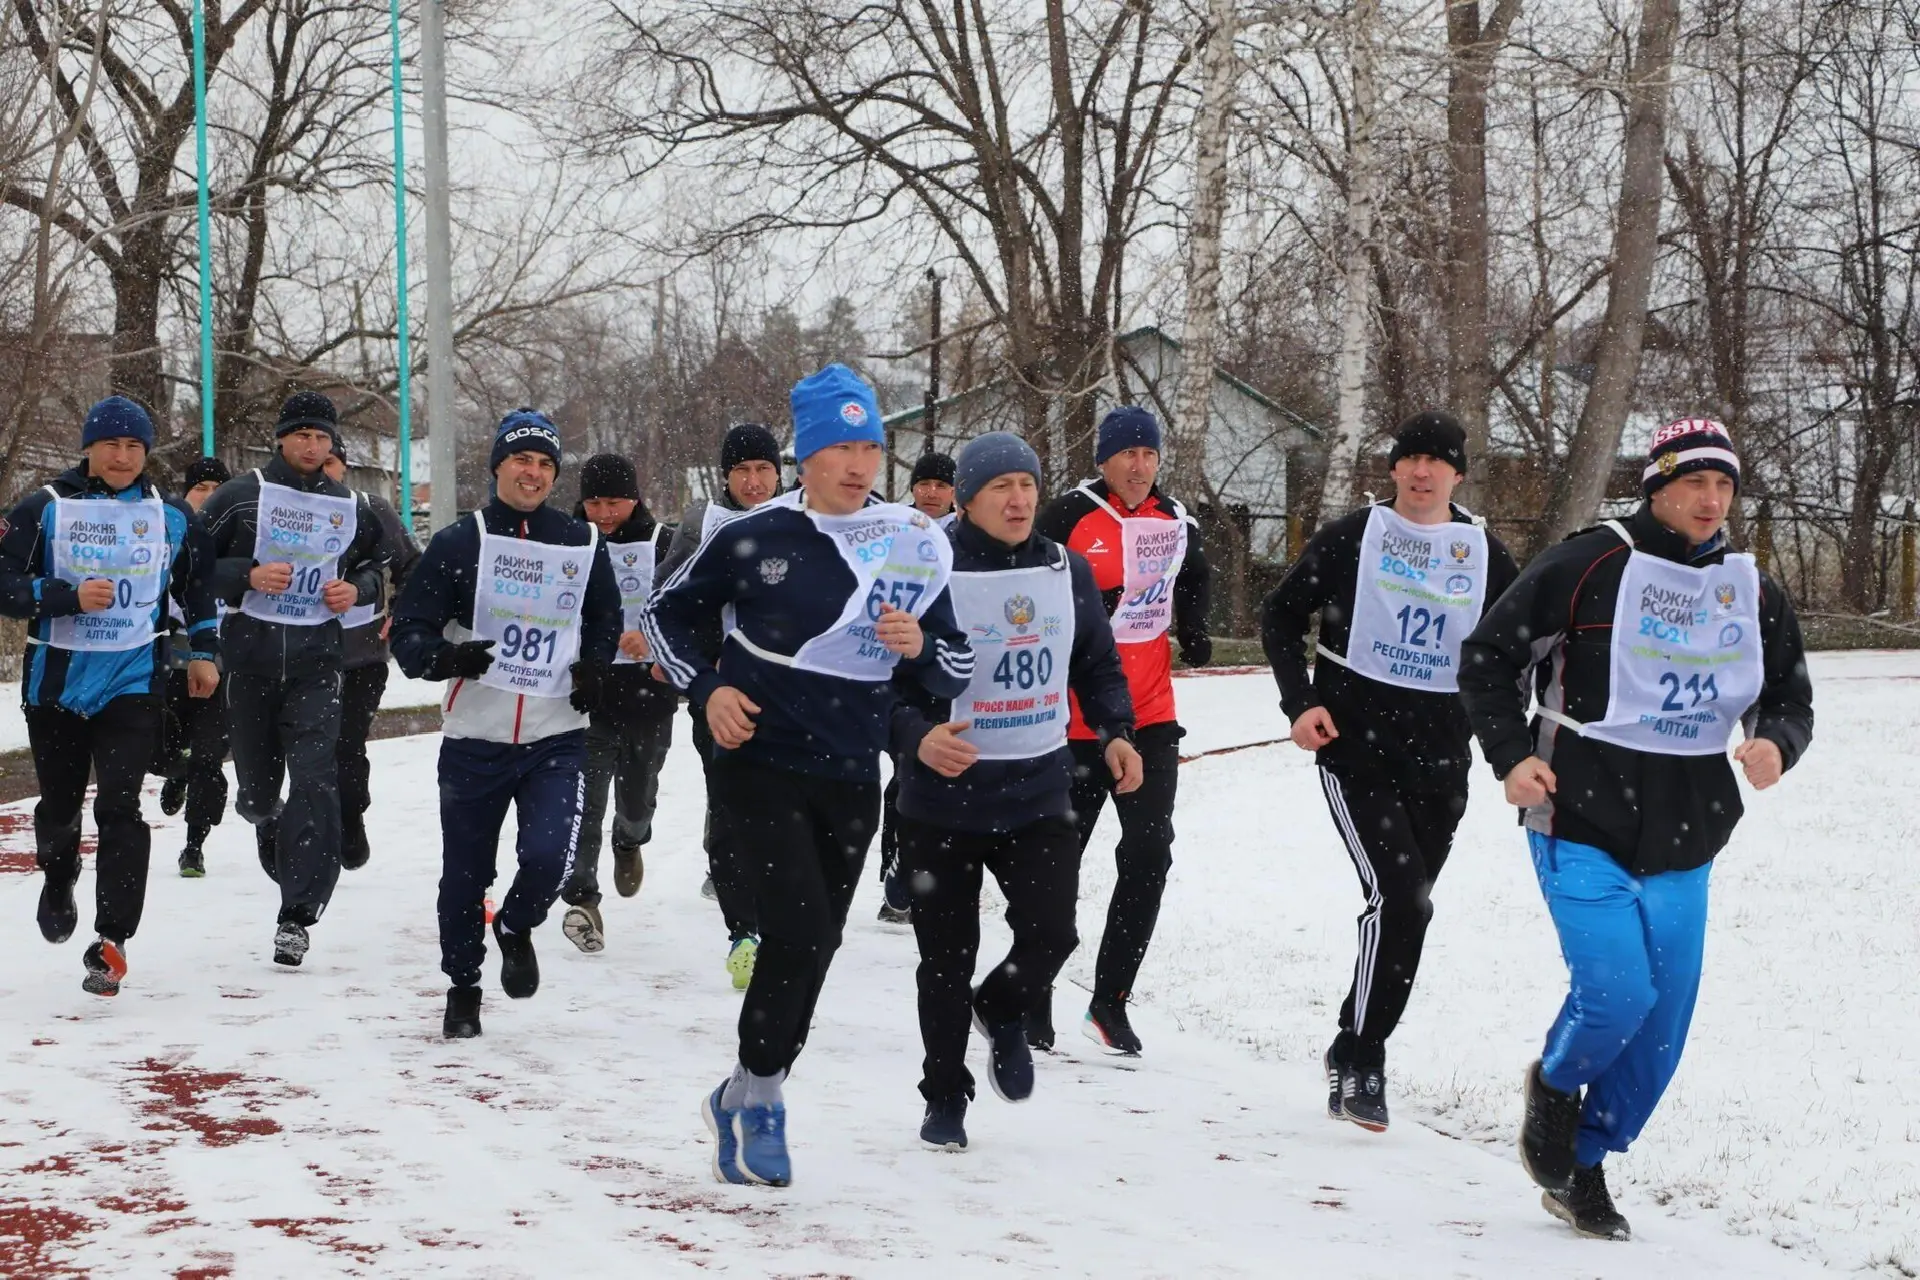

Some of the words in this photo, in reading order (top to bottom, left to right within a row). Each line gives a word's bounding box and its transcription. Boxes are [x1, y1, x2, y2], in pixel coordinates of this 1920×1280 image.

[505, 427, 560, 450] BOSCO
[270, 506, 313, 522] ЛЫЖНЯ
[69, 520, 116, 534] ЛЫЖНЯ
[270, 518, 313, 533] РОССИИ
[69, 532, 117, 546] РОССИИ
[1136, 530, 1177, 546] ЛЫЖНЯ
[72, 544, 112, 561] 2021
[494, 554, 543, 572] ЛЫЖНЯ
[494, 567, 543, 584] РОССИИ
[494, 580, 542, 600] 2023
[1642, 583, 1697, 608] ЛЫЖН
[866, 578, 925, 622] 657
[276, 603, 306, 617] АЛТАЙ
[73, 615, 134, 628] РЕСПУБЛИКА
[1130, 620, 1154, 630] АЛТАЙ
[1397, 604, 1446, 649] 121
[85, 628, 119, 641] АЛТАЙ
[501, 624, 557, 664] 981
[1372, 641, 1451, 667] РЕСПУБЛИКА
[498, 661, 552, 678] РЕСПУБЛИКА
[993, 647, 1052, 690] 480
[1390, 662, 1432, 680] АЛТАЙ
[510, 676, 538, 688] АЛТАЙ
[1659, 671, 1719, 711] 211
[1005, 697, 1034, 712] НАЦИИ
[974, 713, 1034, 729] РЕСПУБЛИКА
[1035, 708, 1057, 723] АЛТАЙ
[1653, 718, 1699, 739] АЛТАЙ
